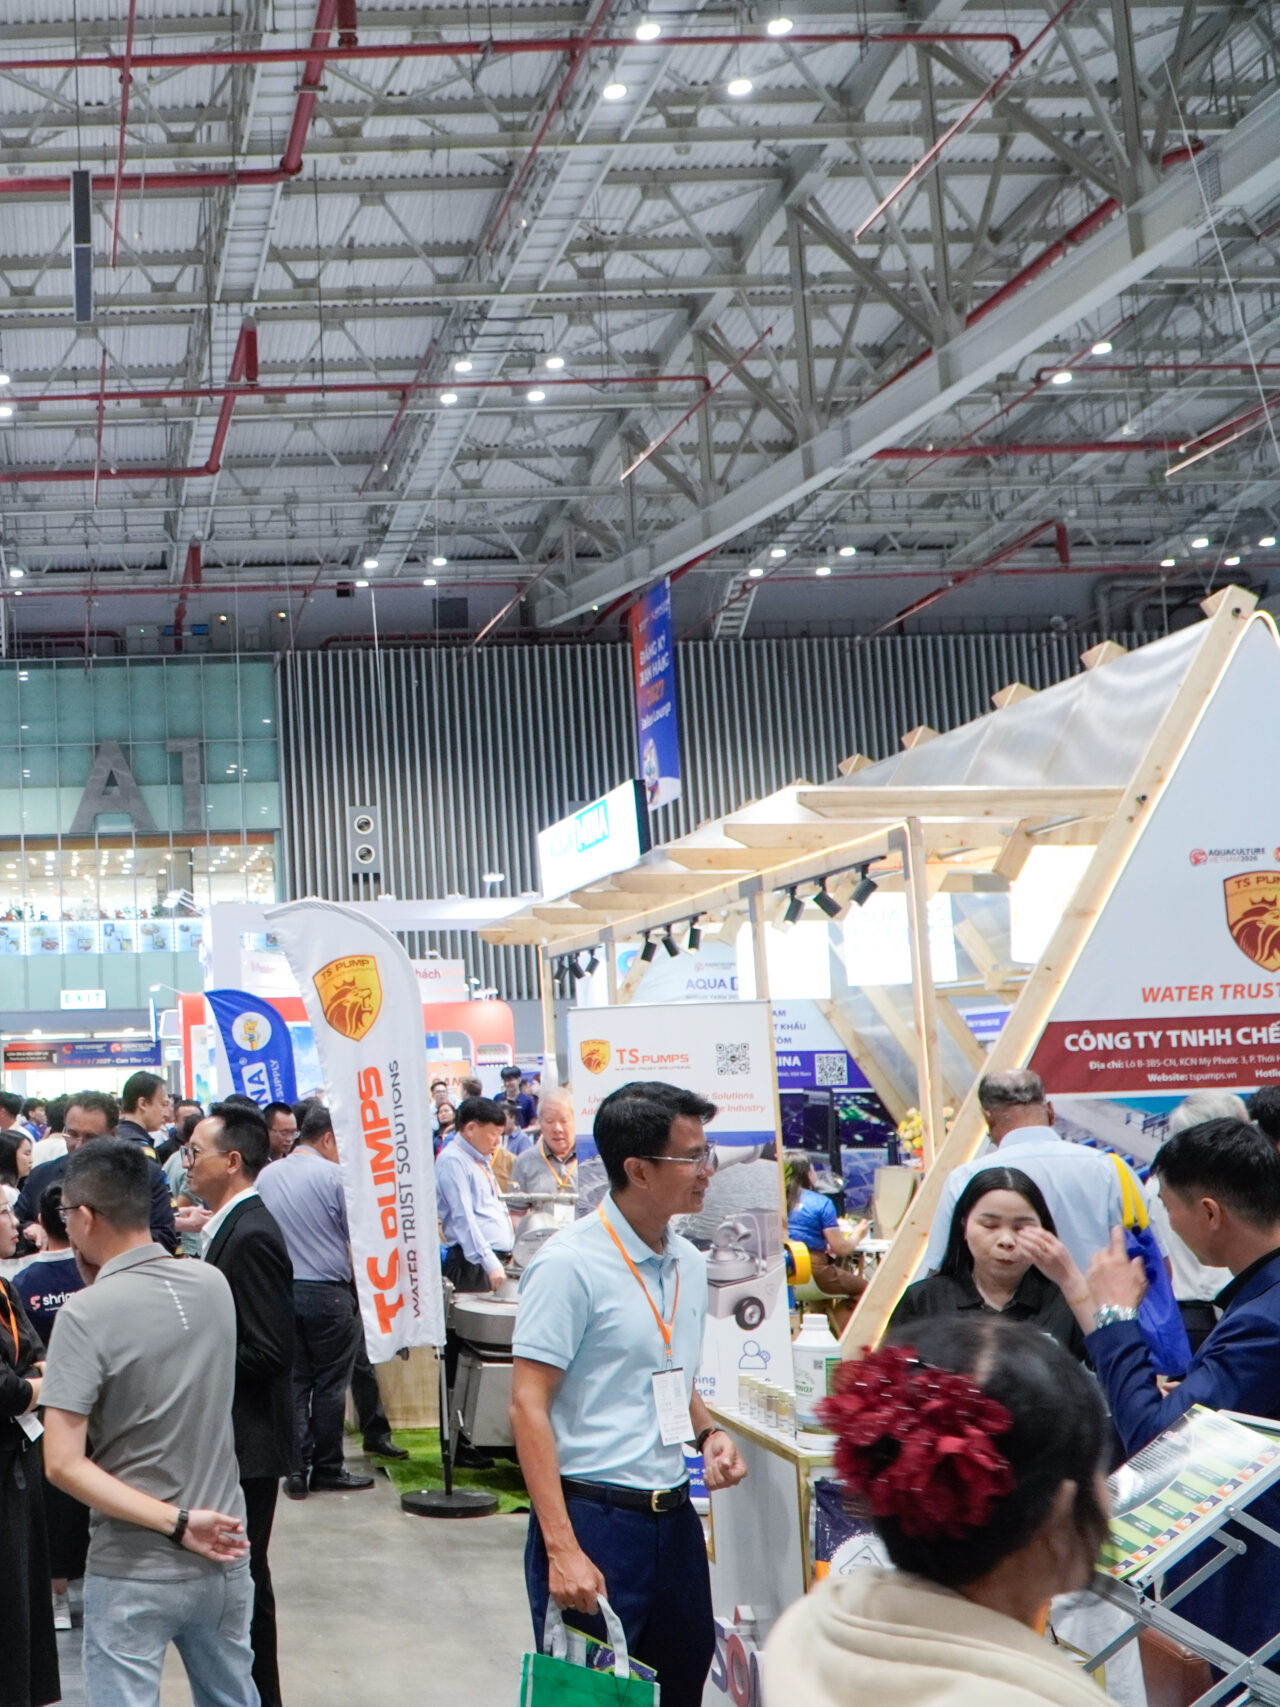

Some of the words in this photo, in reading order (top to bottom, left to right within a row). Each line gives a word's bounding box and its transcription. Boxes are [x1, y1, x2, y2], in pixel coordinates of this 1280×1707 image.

[69, 738, 206, 833] A1
[1209, 847, 1265, 857] AQUACULTURE
[1234, 877, 1251, 889] TS
[321, 968, 333, 981] TS
[335, 957, 370, 972] PUMP
[414, 967, 441, 979] hách
[686, 977, 727, 990] AQUA
[64, 993, 102, 1003] EXIT
[1141, 984, 1214, 1003] WATER
[776, 1035, 793, 1045] ÔM
[1064, 1028, 1132, 1052] CÔNG
[1133, 1030, 1163, 1049] TY
[1166, 1027, 1231, 1048] TNHH
[615, 1048, 639, 1065] TS
[642, 1053, 689, 1064] PUMPS
[777, 1055, 802, 1067] INA
[1089, 1060, 1106, 1071] Địa
[1180, 1056, 1198, 1067] KCN
[269, 1059, 285, 1098] SUPPLY
[1147, 1073, 1188, 1083] Website:
[1189, 1072, 1237, 1083] tspumps.vn
[247, 1068, 269, 1105] NA
[711, 1091, 755, 1101] Solutions
[388, 1059, 411, 1175] SOLUTIONS
[727, 1104, 766, 1116] Industry
[399, 1181, 417, 1245] TRUST
[406, 1249, 421, 1319] WATER
[697, 1387, 716, 1397] nce
